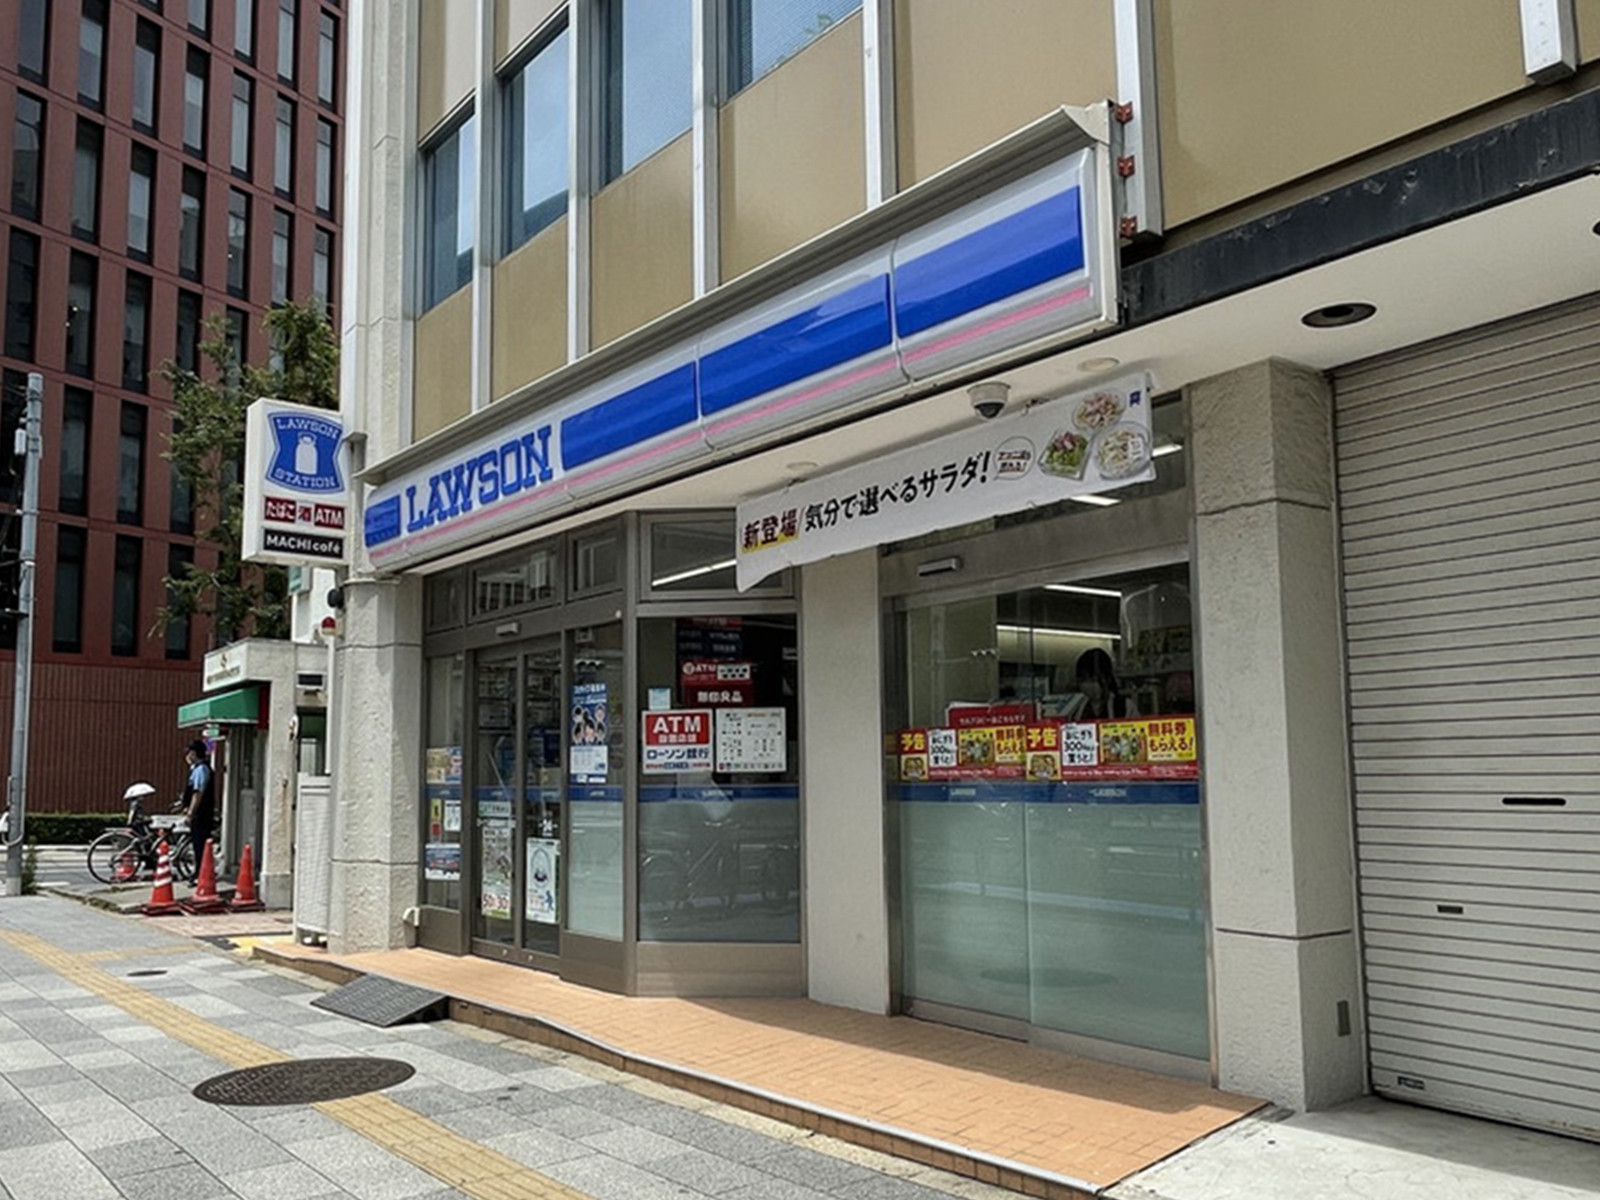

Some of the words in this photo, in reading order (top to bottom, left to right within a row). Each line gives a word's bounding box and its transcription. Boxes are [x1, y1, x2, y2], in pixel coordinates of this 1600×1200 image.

[275, 418, 339, 440] LAWSON
[273, 467, 336, 487] STATION
[405, 424, 553, 533] LAWSON
[743, 508, 797, 549] 新登場
[804, 451, 991, 532] 気分で選べるサラダ!
[315, 508, 344, 525] ATM
[266, 535, 312, 550] MACHI
[652, 716, 702, 734] ATM
[901, 733, 925, 752] 予告
[1028, 727, 1057, 748] 予告
[1149, 737, 1194, 752] もらえる!
